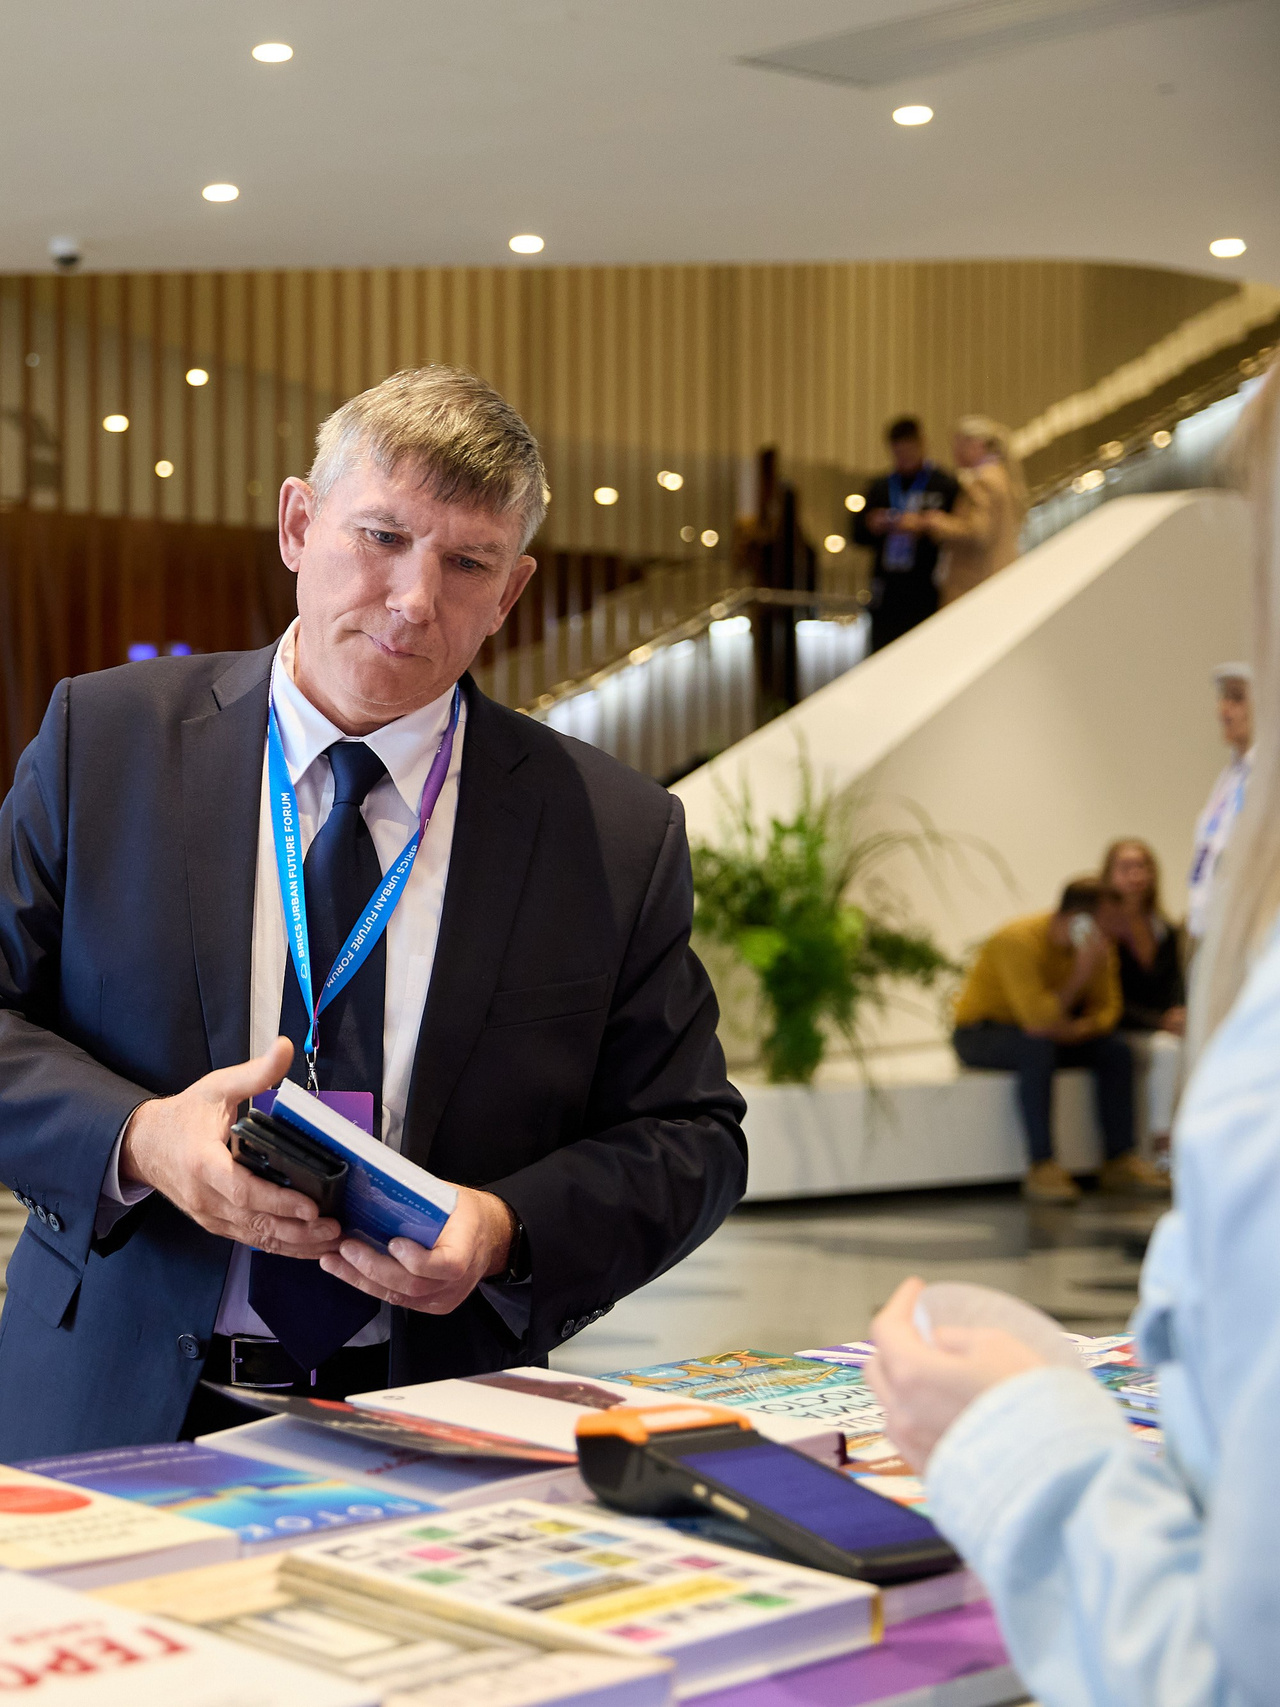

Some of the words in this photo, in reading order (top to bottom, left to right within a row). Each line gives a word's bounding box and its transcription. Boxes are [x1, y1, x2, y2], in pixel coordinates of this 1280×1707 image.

[280, 792, 294, 833] FORUM
[285, 835, 298, 879] FUTURE
[396, 844, 418, 874] BRICS
[289, 880, 301, 922] URBAN
[373, 875, 400, 912] URBAN
[294, 923, 305, 959] BRICS
[350, 910, 379, 952] FUTURE
[326, 950, 355, 988] FORUM
